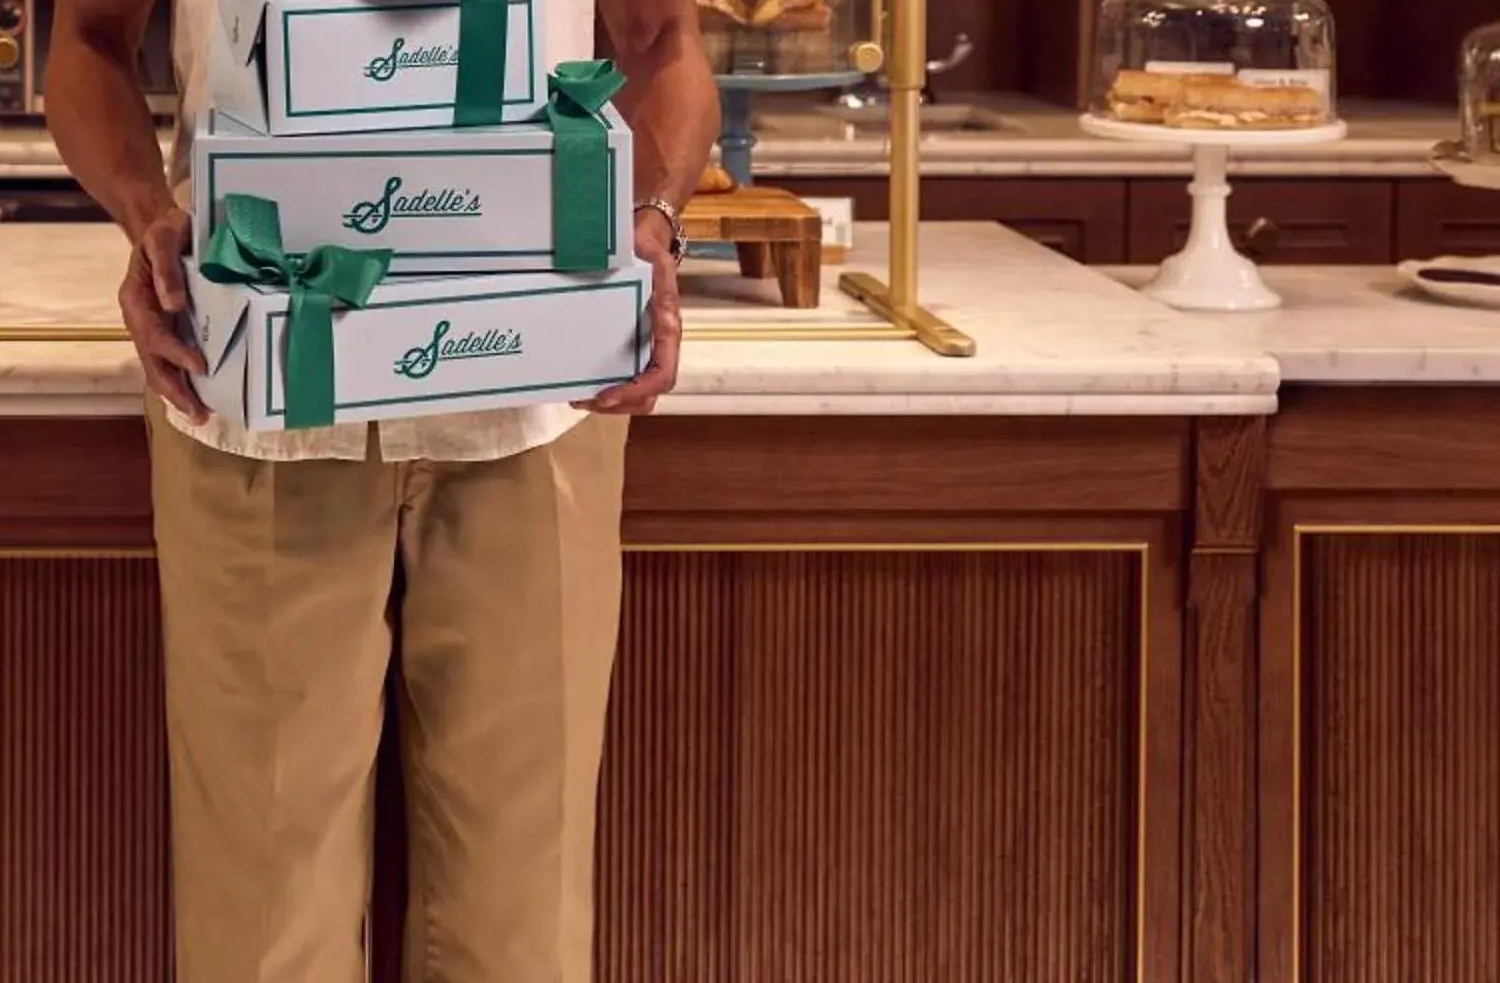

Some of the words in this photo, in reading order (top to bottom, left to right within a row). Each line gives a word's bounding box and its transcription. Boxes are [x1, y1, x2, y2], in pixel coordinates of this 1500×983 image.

[363, 37, 460, 82] Sadelle's
[341, 176, 483, 234] Sadelle's
[393, 320, 523, 379] Sadelle's
